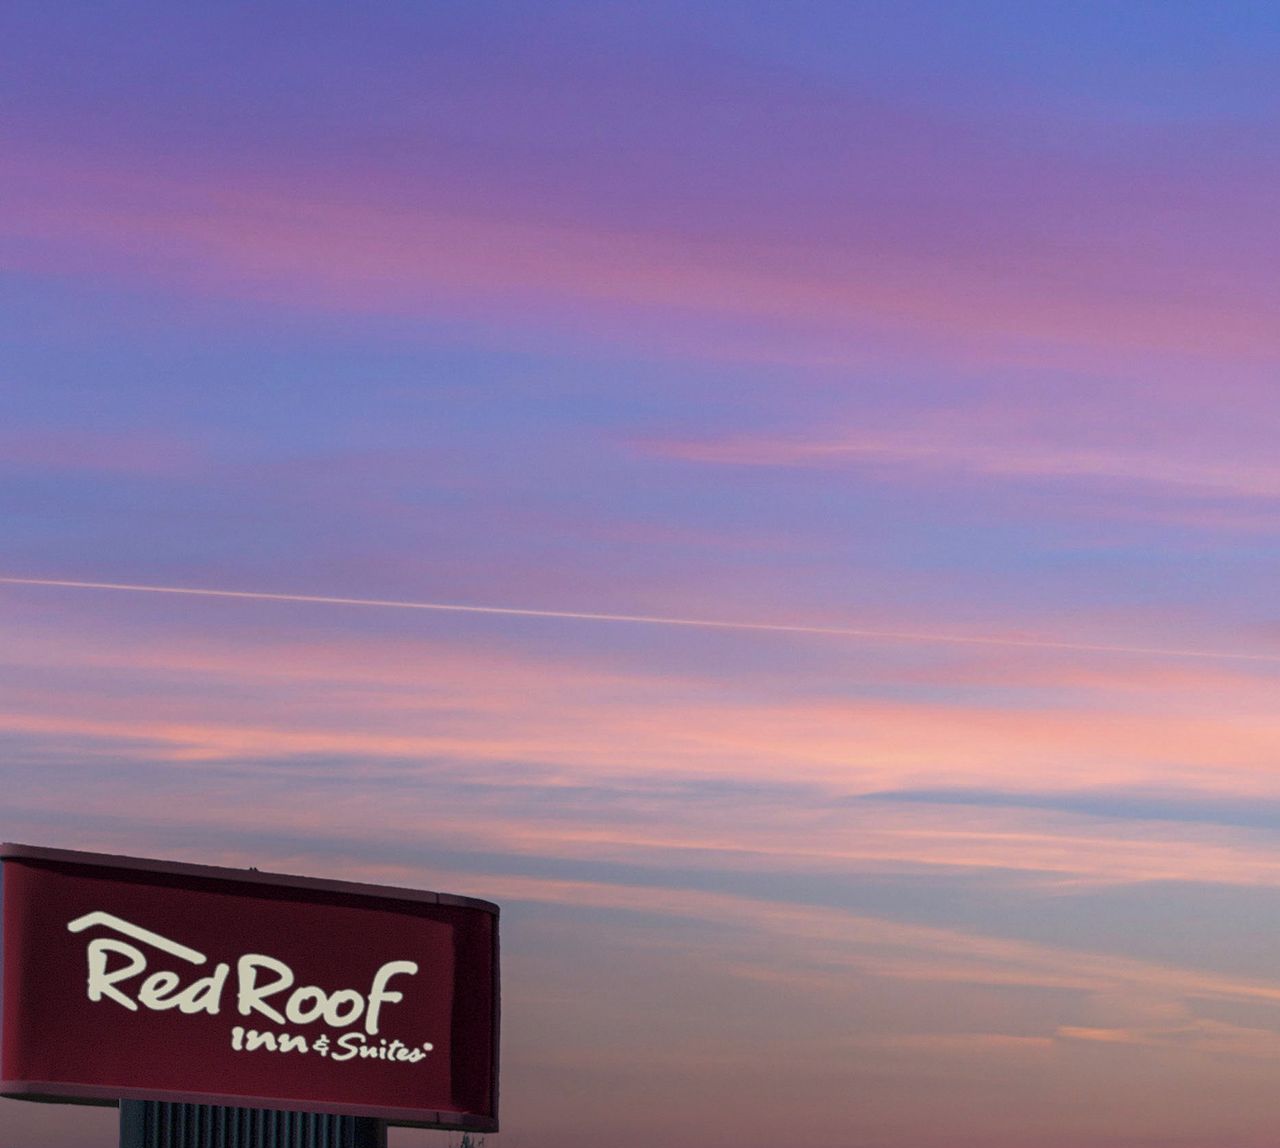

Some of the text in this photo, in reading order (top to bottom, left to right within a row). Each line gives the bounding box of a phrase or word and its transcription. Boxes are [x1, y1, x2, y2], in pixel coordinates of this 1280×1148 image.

[88, 938, 419, 1035] Red Roof
[312, 1034, 330, 1057] &
[331, 1032, 427, 1063] Suites
